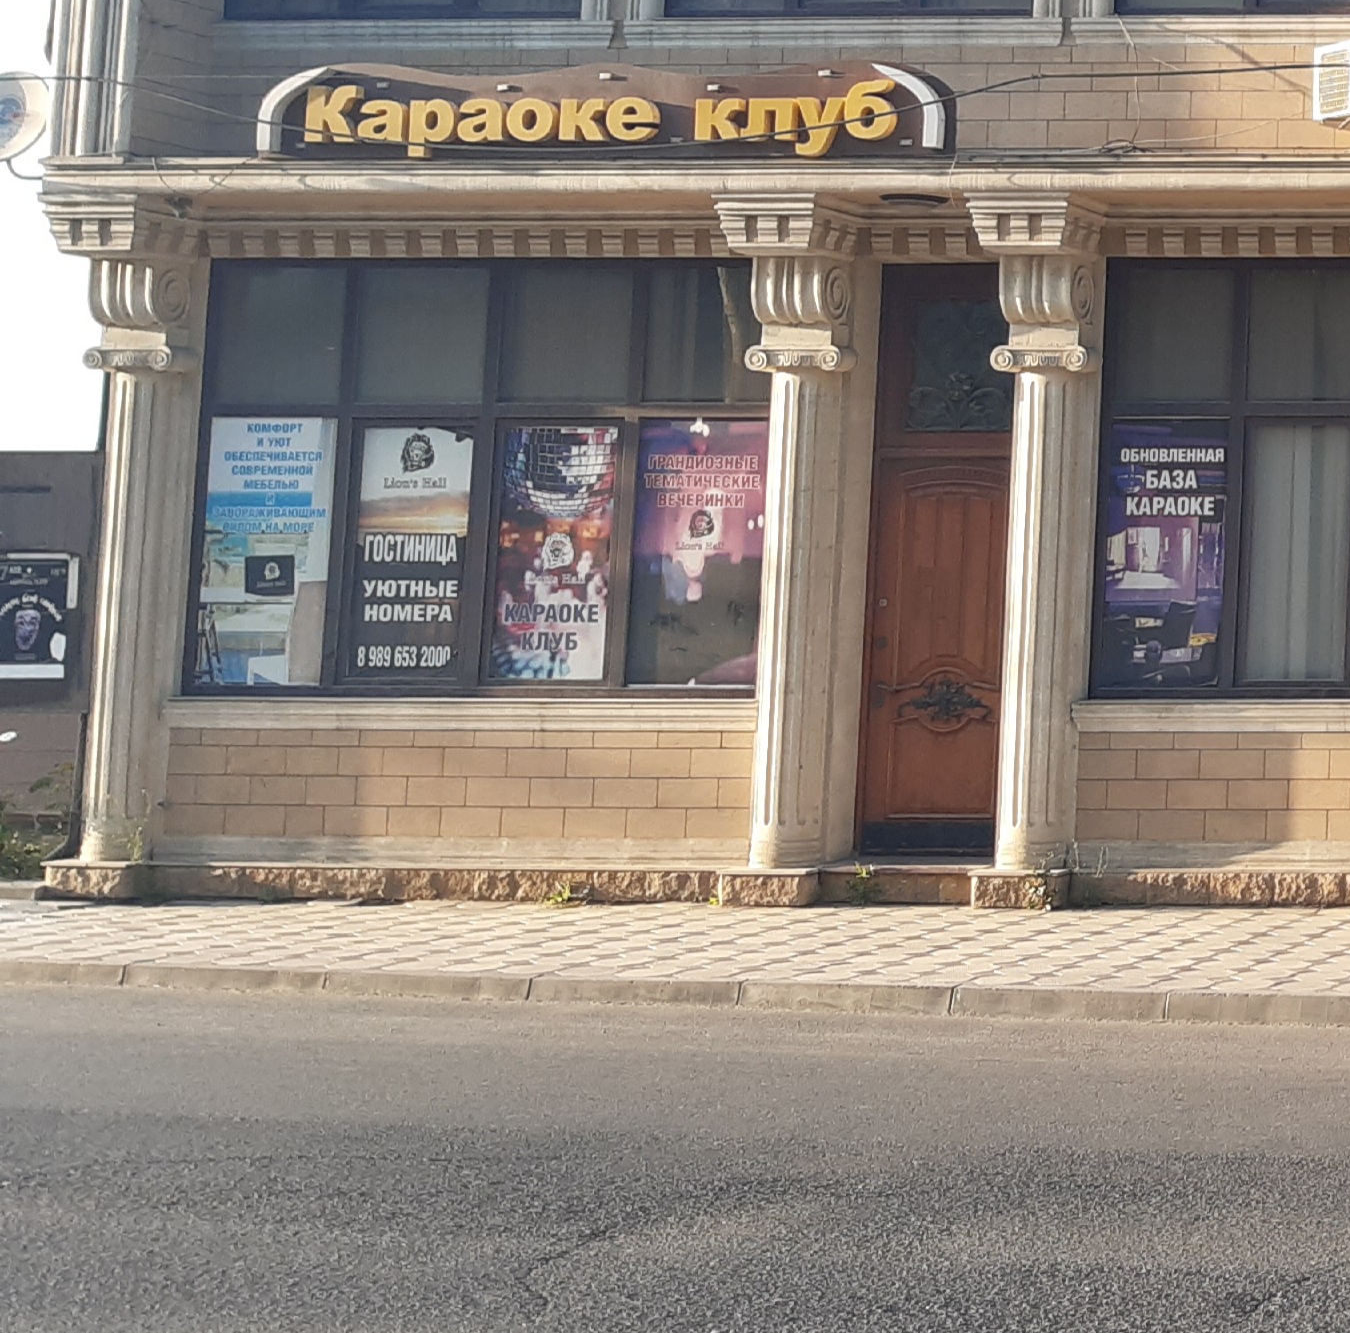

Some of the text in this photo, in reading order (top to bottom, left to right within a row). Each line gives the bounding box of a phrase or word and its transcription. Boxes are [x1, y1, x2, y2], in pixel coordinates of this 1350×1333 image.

[304, 79, 897, 158] Караоке клуб
[247, 423, 303, 434] КОМФОРТ
[257, 437, 291, 447] И УЮТ
[224, 450, 323, 462] ОБЕСПЕЧИВАЕТСЯ
[648, 454, 759, 470] ГРАНДИОЗНЫЕ
[1120, 448, 1225, 463] ОБНОВЛЕННАЯ
[231, 464, 313, 476] СОВРЕМЕННОЙ
[243, 479, 299, 489] МЕБЕЛЬЮ
[644, 473, 760, 489] ТЕМАТИЧЕСКИЕ
[1145, 470, 1198, 489] БАЗА
[657, 493, 745, 508] ВЕЧЕРИНКИ
[1125, 496, 1215, 516] КАРАОКЕ
[283, 522, 314, 533] МОРЕ
[364, 534, 457, 566] ГОСТИНИЦА
[362, 579, 458, 598] УЮТНЫЕ
[364, 604, 453, 622] НОМЕРА
[504, 603, 599, 623] КАРАОКЕ
[521, 631, 578, 651] КЛУБ
[357, 645, 366, 667] 8
[368, 645, 391, 667] 989
[394, 645, 417, 667] 653
